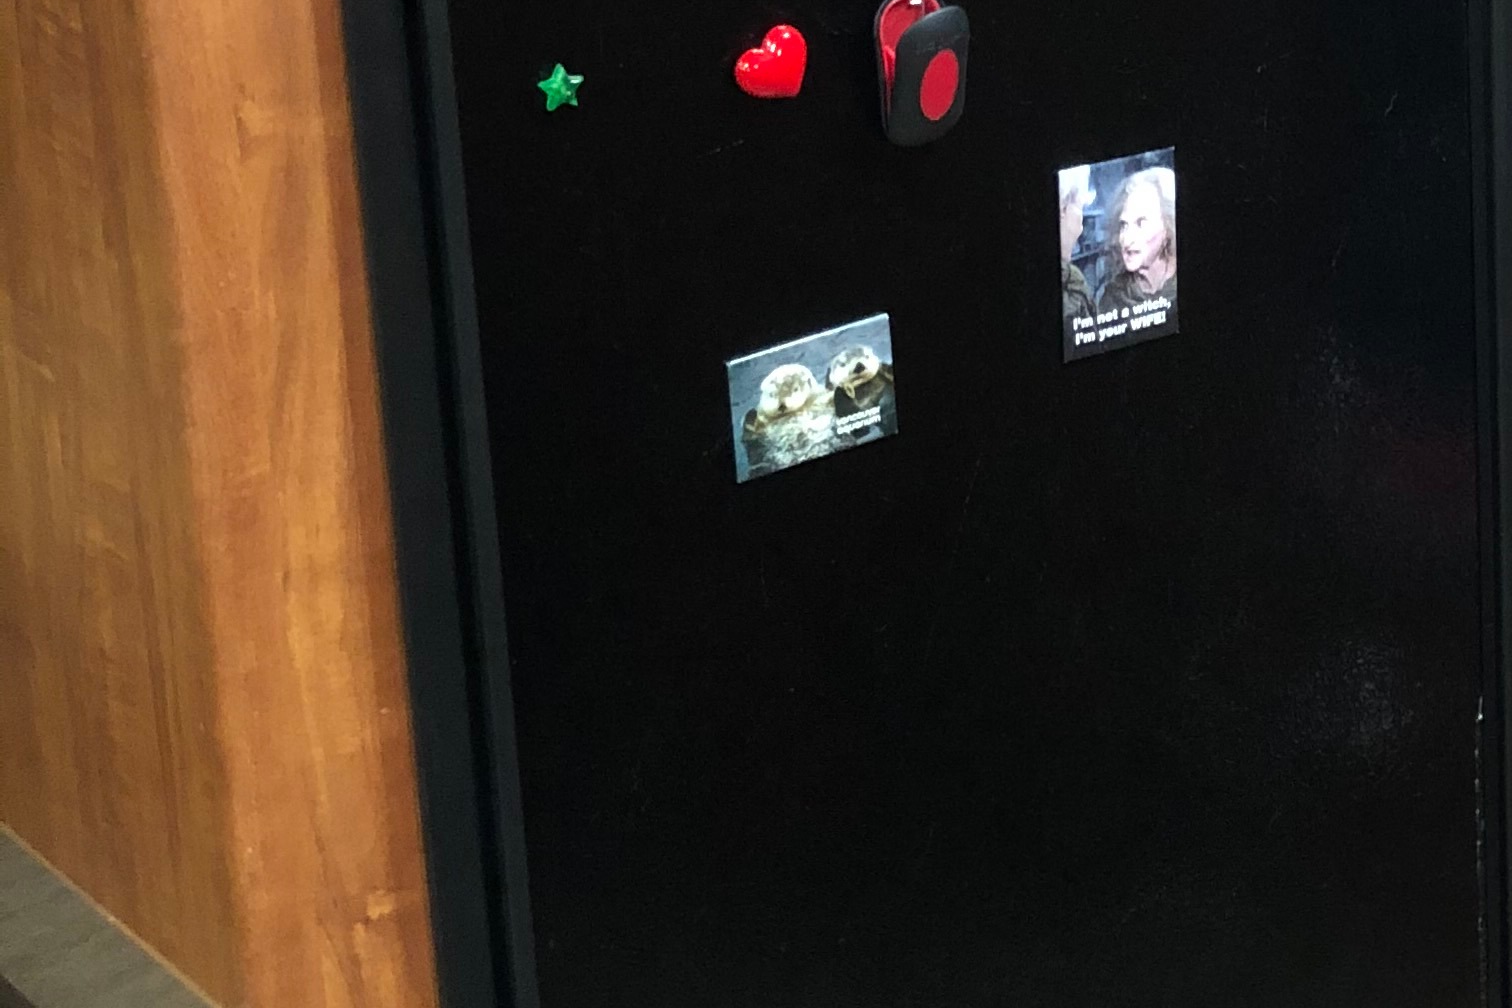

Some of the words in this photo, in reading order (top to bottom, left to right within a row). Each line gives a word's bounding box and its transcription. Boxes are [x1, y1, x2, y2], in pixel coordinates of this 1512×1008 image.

[1073, 317, 1094, 331] I'm
[1096, 308, 1118, 324] not
[1121, 307, 1130, 318] a
[1075, 332, 1096, 346] I'm
[1098, 323, 1128, 342] your
